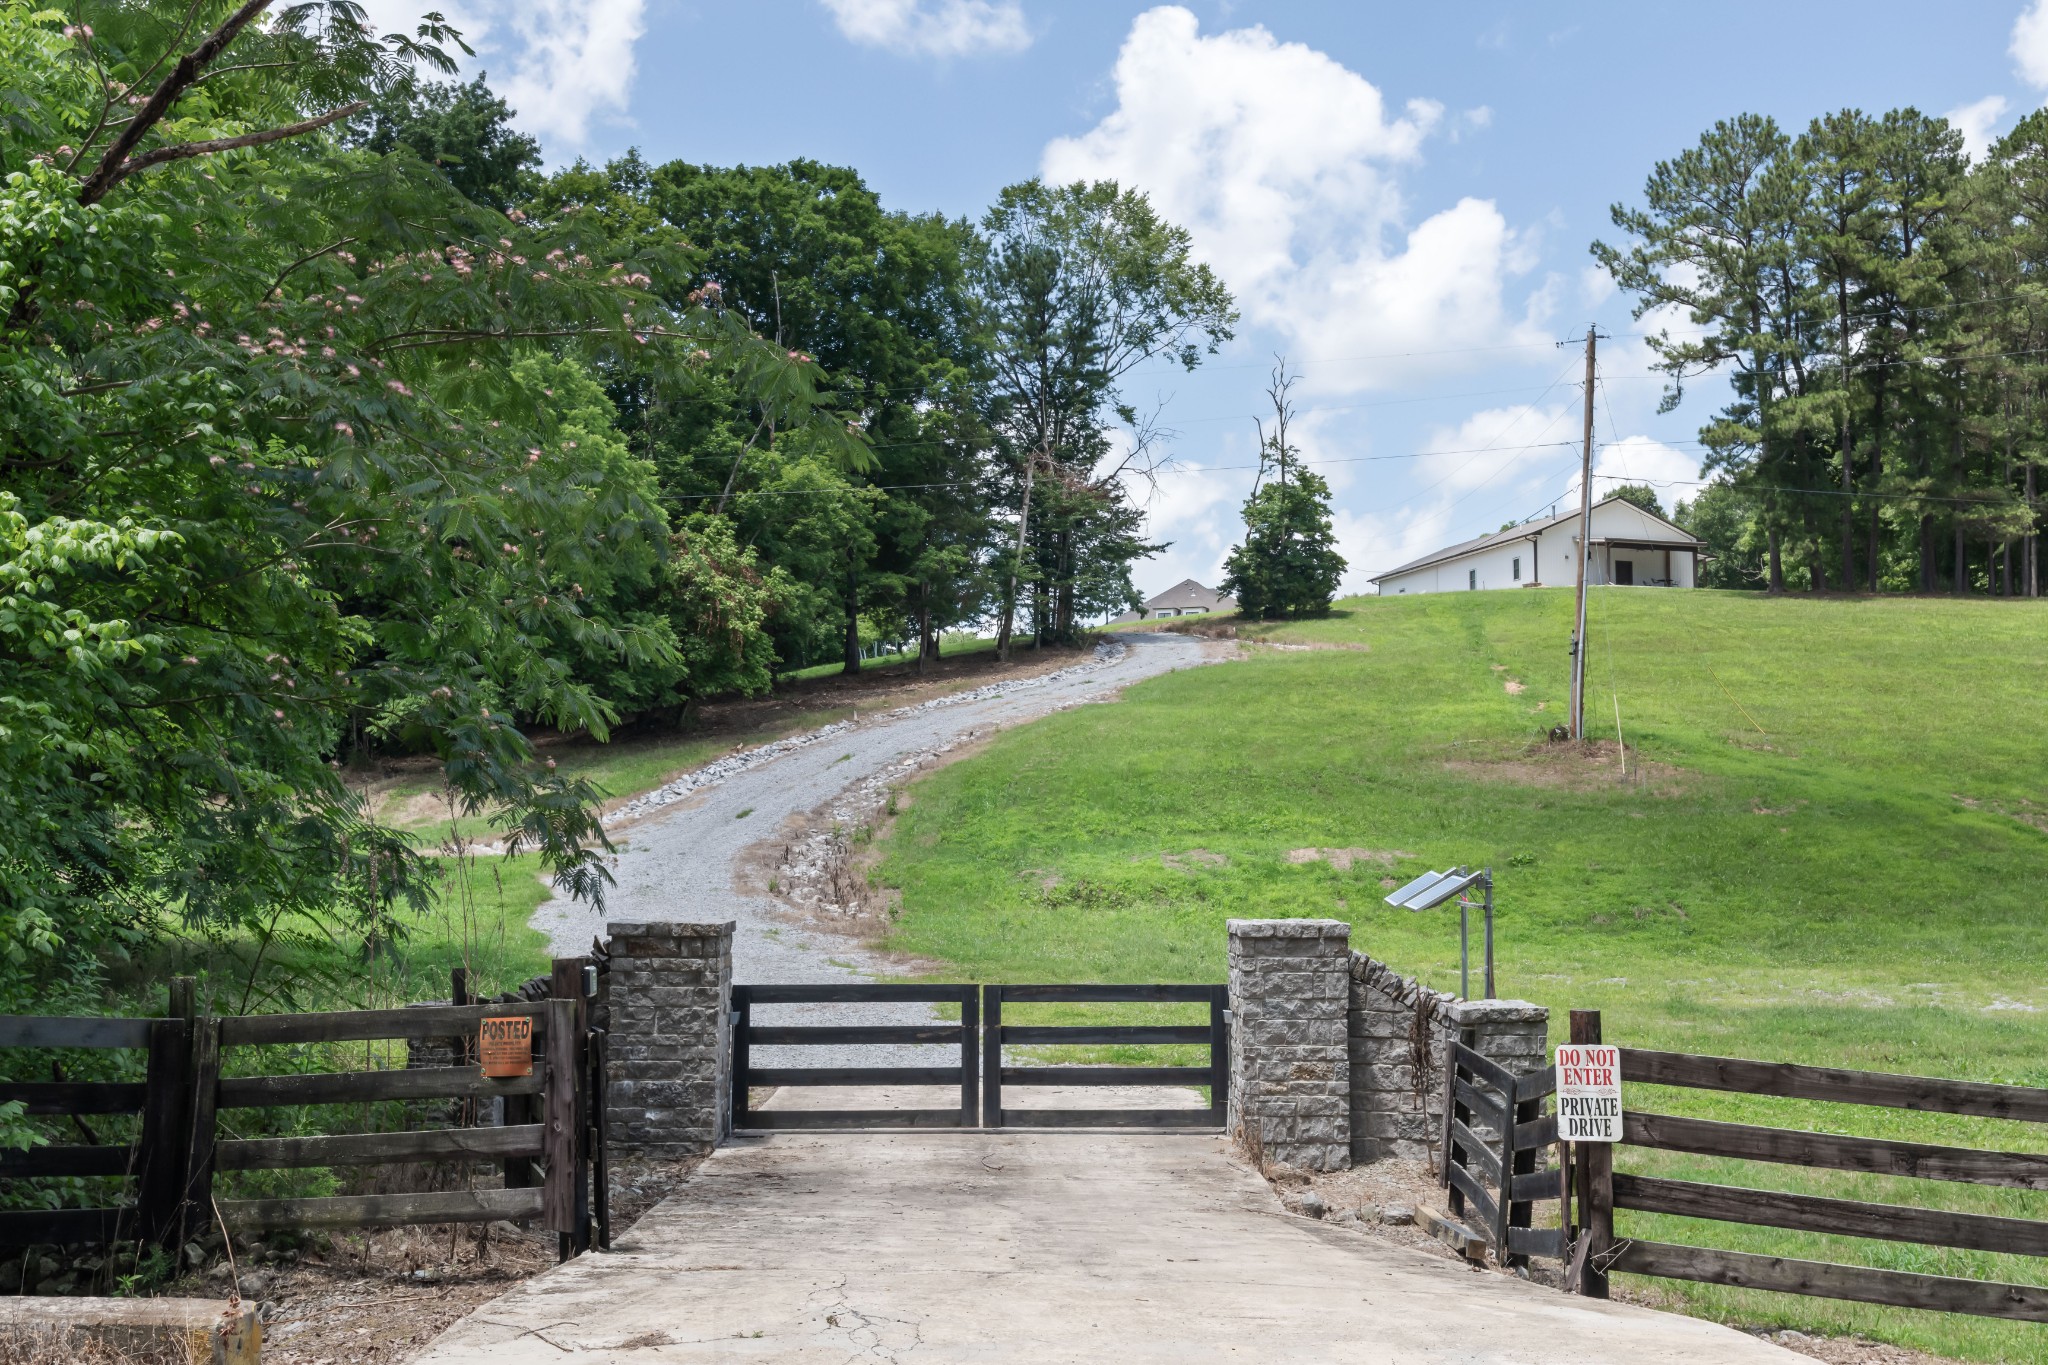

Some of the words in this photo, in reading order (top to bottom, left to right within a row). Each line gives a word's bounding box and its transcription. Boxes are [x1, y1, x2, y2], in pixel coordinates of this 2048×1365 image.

[482, 1021, 529, 1040] POSTED
[1559, 1049, 1581, 1067] DO
[1586, 1049, 1616, 1067] NOT
[1564, 1068, 1613, 1085] ENTER
[1561, 1098, 1618, 1117] PRIVATE
[1569, 1118, 1612, 1137] DRIVE
